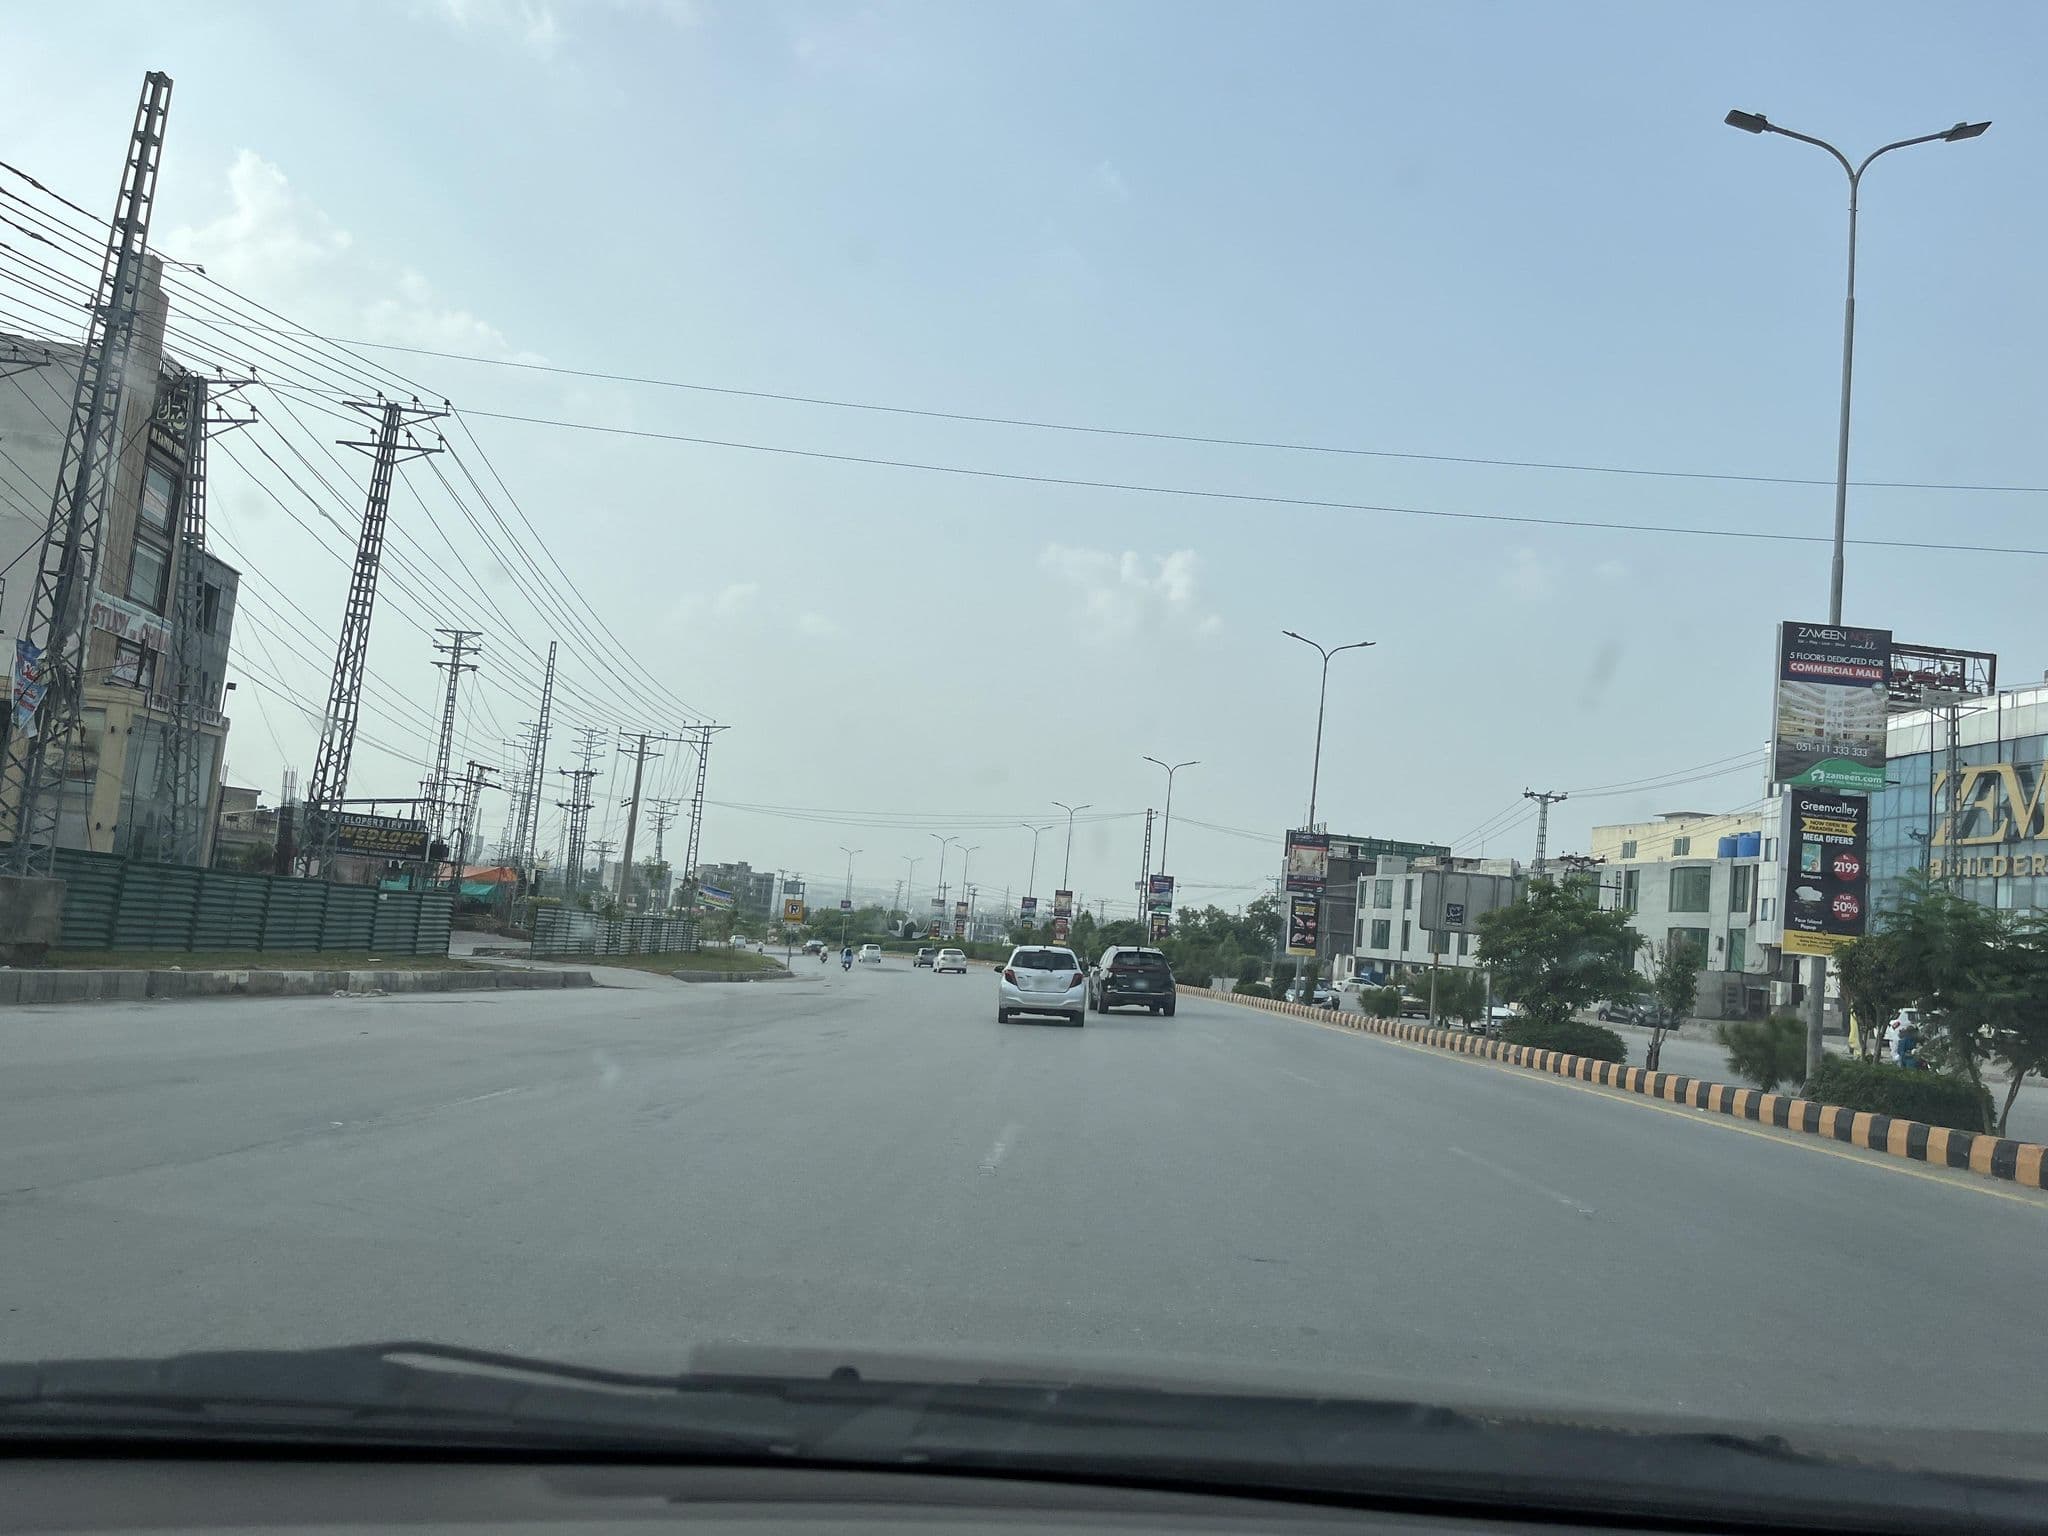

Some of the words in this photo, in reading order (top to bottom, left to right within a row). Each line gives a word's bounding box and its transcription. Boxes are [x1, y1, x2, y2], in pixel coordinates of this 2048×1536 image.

[1798, 627, 1847, 640] ZAMEEN
[1789, 651, 1795, 659] 5
[1796, 652, 1825, 661] FLOORS
[1827, 655, 1867, 665] DEDICATED
[1868, 659, 1884, 667] FOR
[1790, 662, 1853, 676] COMMERCIAL
[1855, 668, 1881, 678] MALL
[1796, 742, 1830, 753] 051-111
[1832, 745, 1849, 755] 333
[1852, 747, 1868, 757] 333
[1825, 772, 1882, 784] zameen.com
[1800, 800, 1858, 817] Greenvalley
[339, 825, 424, 845] WEDLOCK
[1803, 833, 1824, 842] MEGA
[1825, 836, 1854, 845] OFFERS
[1834, 861, 1859, 873] 2199
[1832, 901, 1858, 914] 50%
